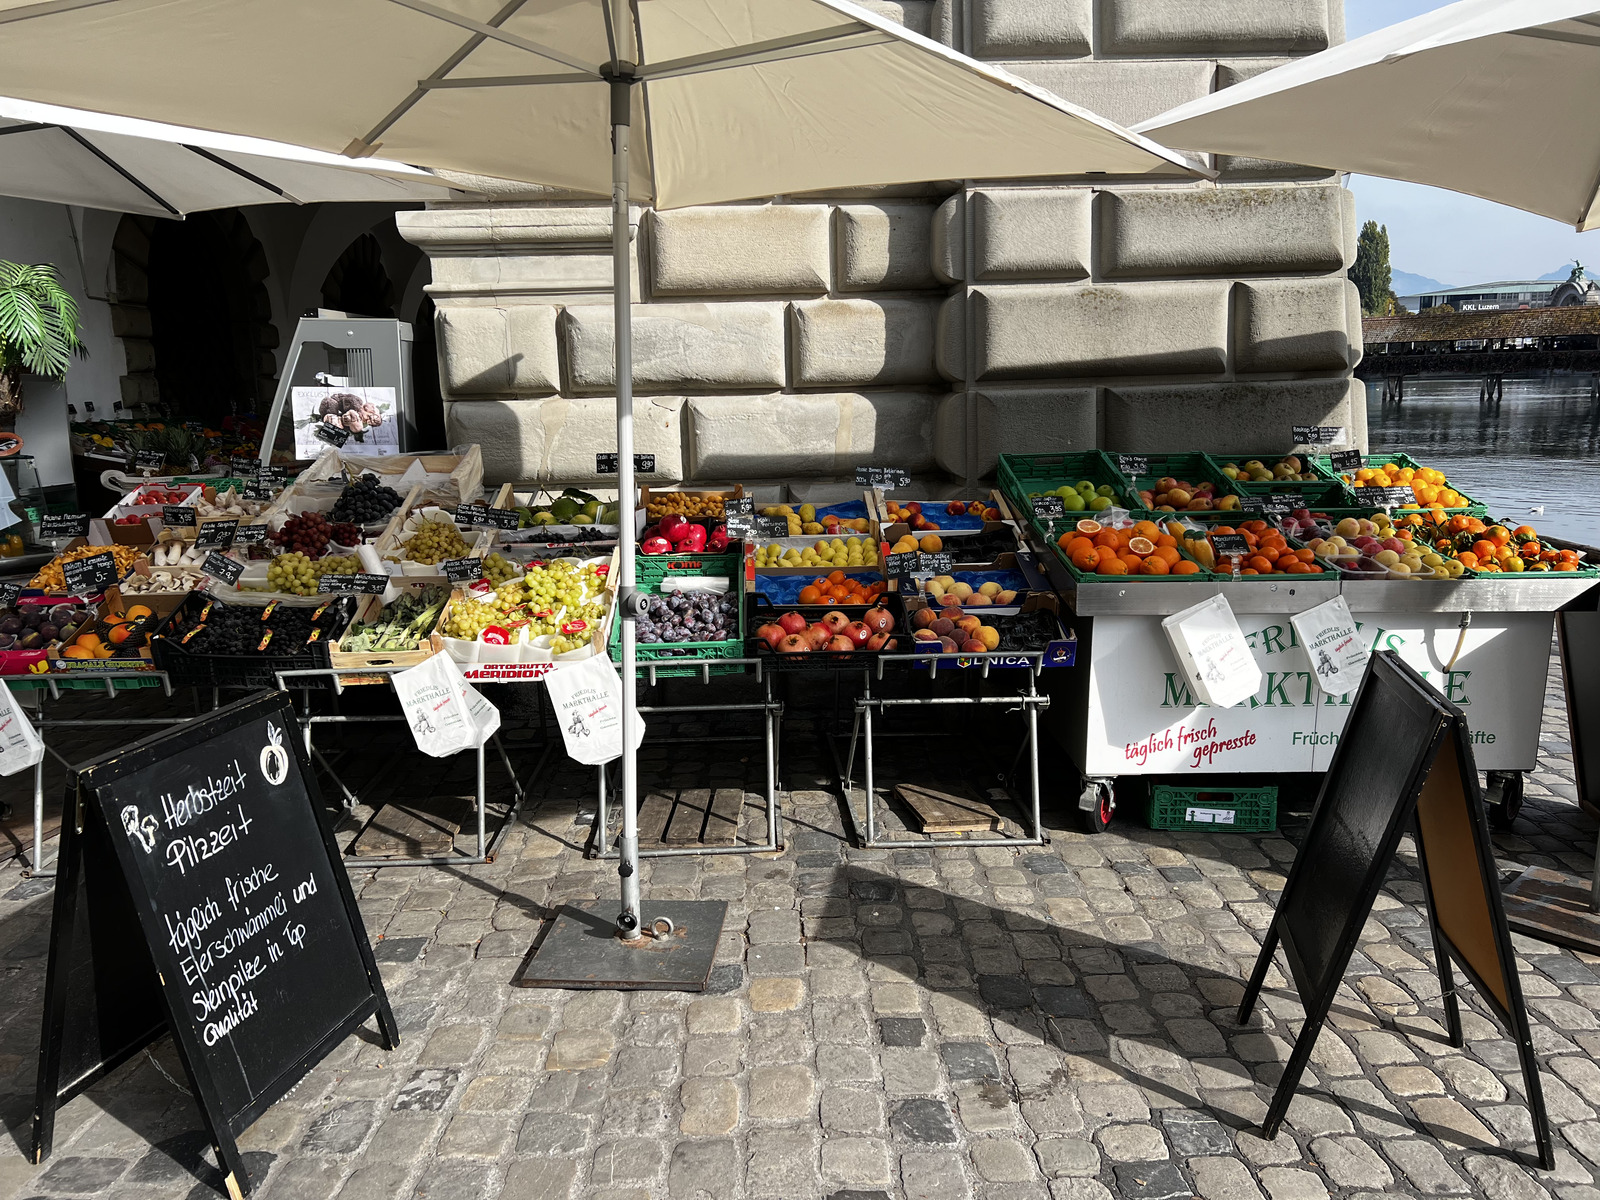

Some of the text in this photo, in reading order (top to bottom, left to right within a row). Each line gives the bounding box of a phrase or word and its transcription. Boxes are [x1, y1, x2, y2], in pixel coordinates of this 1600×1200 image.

[1308, 627, 1354, 651] MARKTHALLE
[463, 669, 550, 679] MERIDION
[484, 662, 554, 670] ORTOFRUTTA
[562, 690, 610, 711] MARKTHALLE
[1124, 717, 1218, 766] täglich frisch
[1189, 729, 1257, 769] gepresste
[1292, 731, 1340, 746] Früch
[160, 759, 248, 831] Herbstzeit
[165, 803, 253, 875] Pilzzeit
[225, 863, 279, 912] frische
[292, 871, 318, 904] und
[192, 920, 307, 1022] Steinpilze in Top
[203, 990, 259, 1047] Qualität
